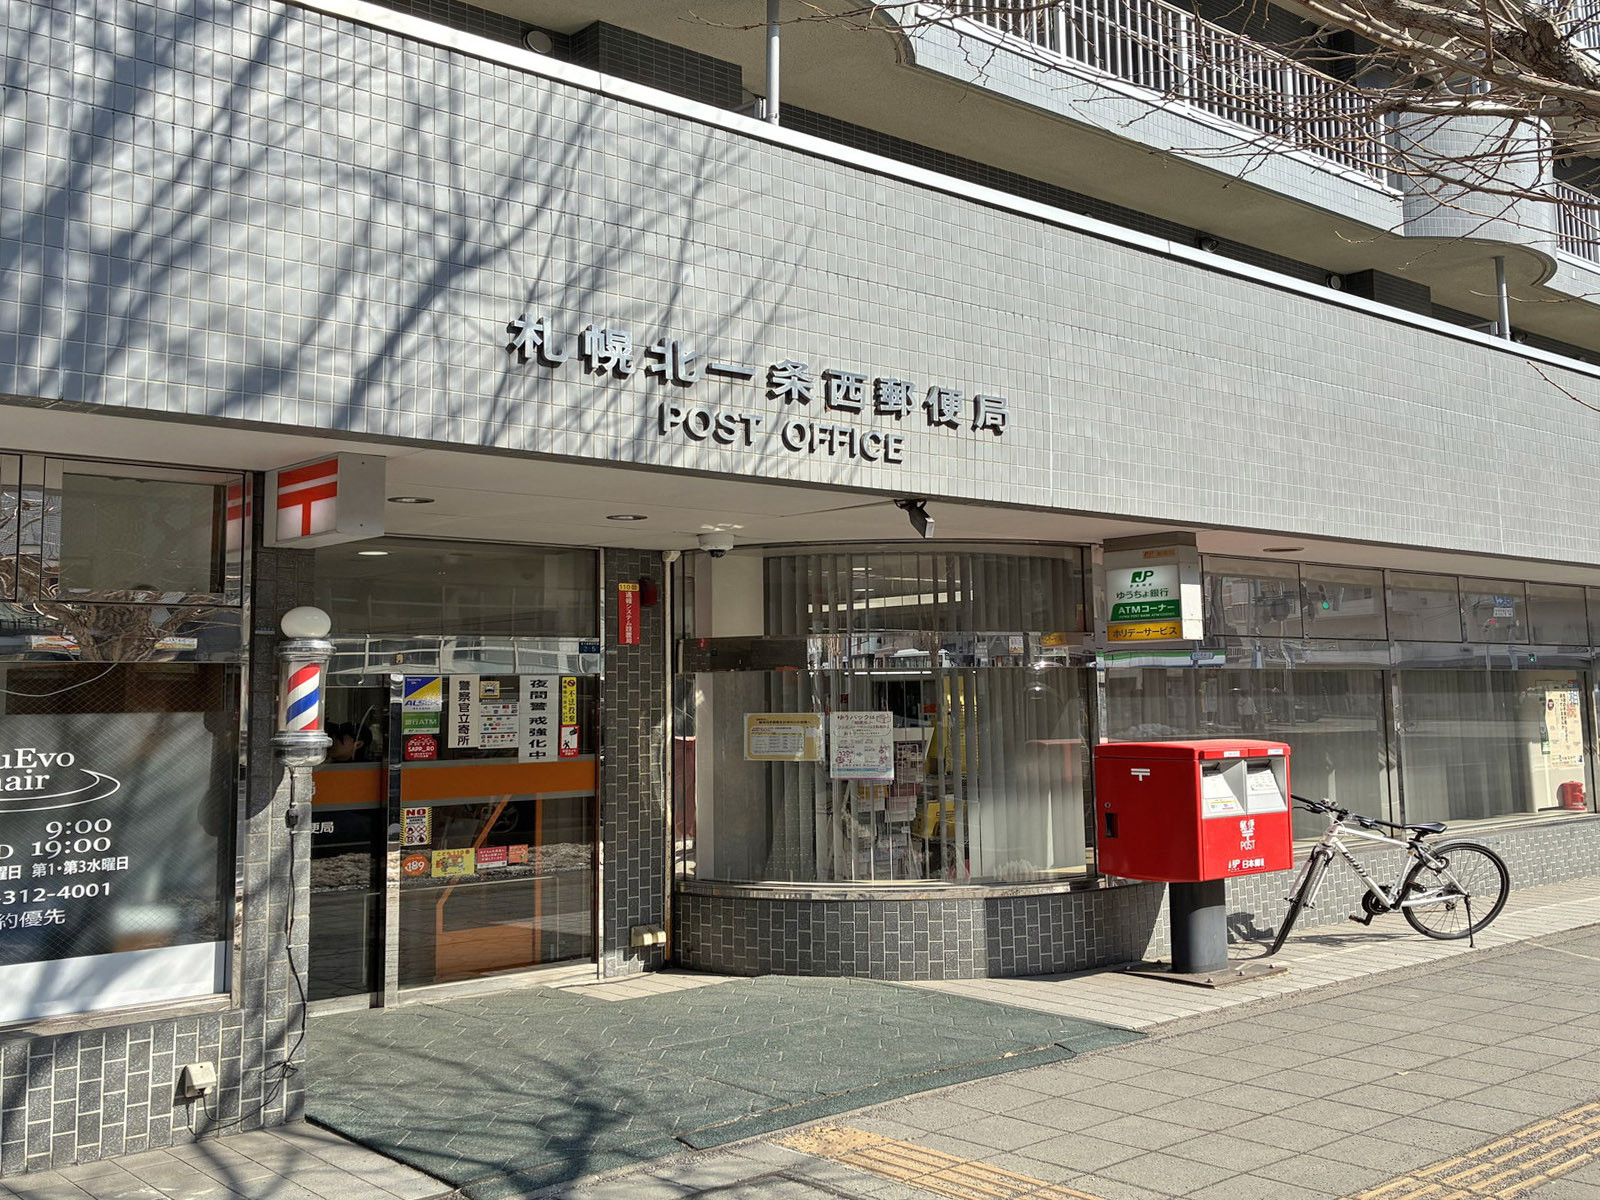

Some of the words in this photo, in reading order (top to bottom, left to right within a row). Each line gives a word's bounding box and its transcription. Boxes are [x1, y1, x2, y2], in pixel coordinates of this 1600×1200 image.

[506, 312, 1010, 436] 札幌北一条西郵便局
[659, 402, 764, 447] POST
[782, 419, 906, 464] OFFICE
[1130, 570, 1154, 583] JP
[1116, 588, 1169, 600] ゆうちょ銀行
[1118, 603, 1176, 615] ATMコーナー
[1112, 626, 1178, 639] ホリデーサービス
[458, 680, 471, 747] 警察官立寄所
[528, 680, 549, 760] 夜間警戒強化中
[0, 768, 50, 792] air
[406, 808, 427, 816] NO
[45, 817, 112, 840] 9:00
[31, 836, 111, 859] 19:00
[1240, 839, 1256, 851] POST
[0, 882, 110, 905] 312-4001
